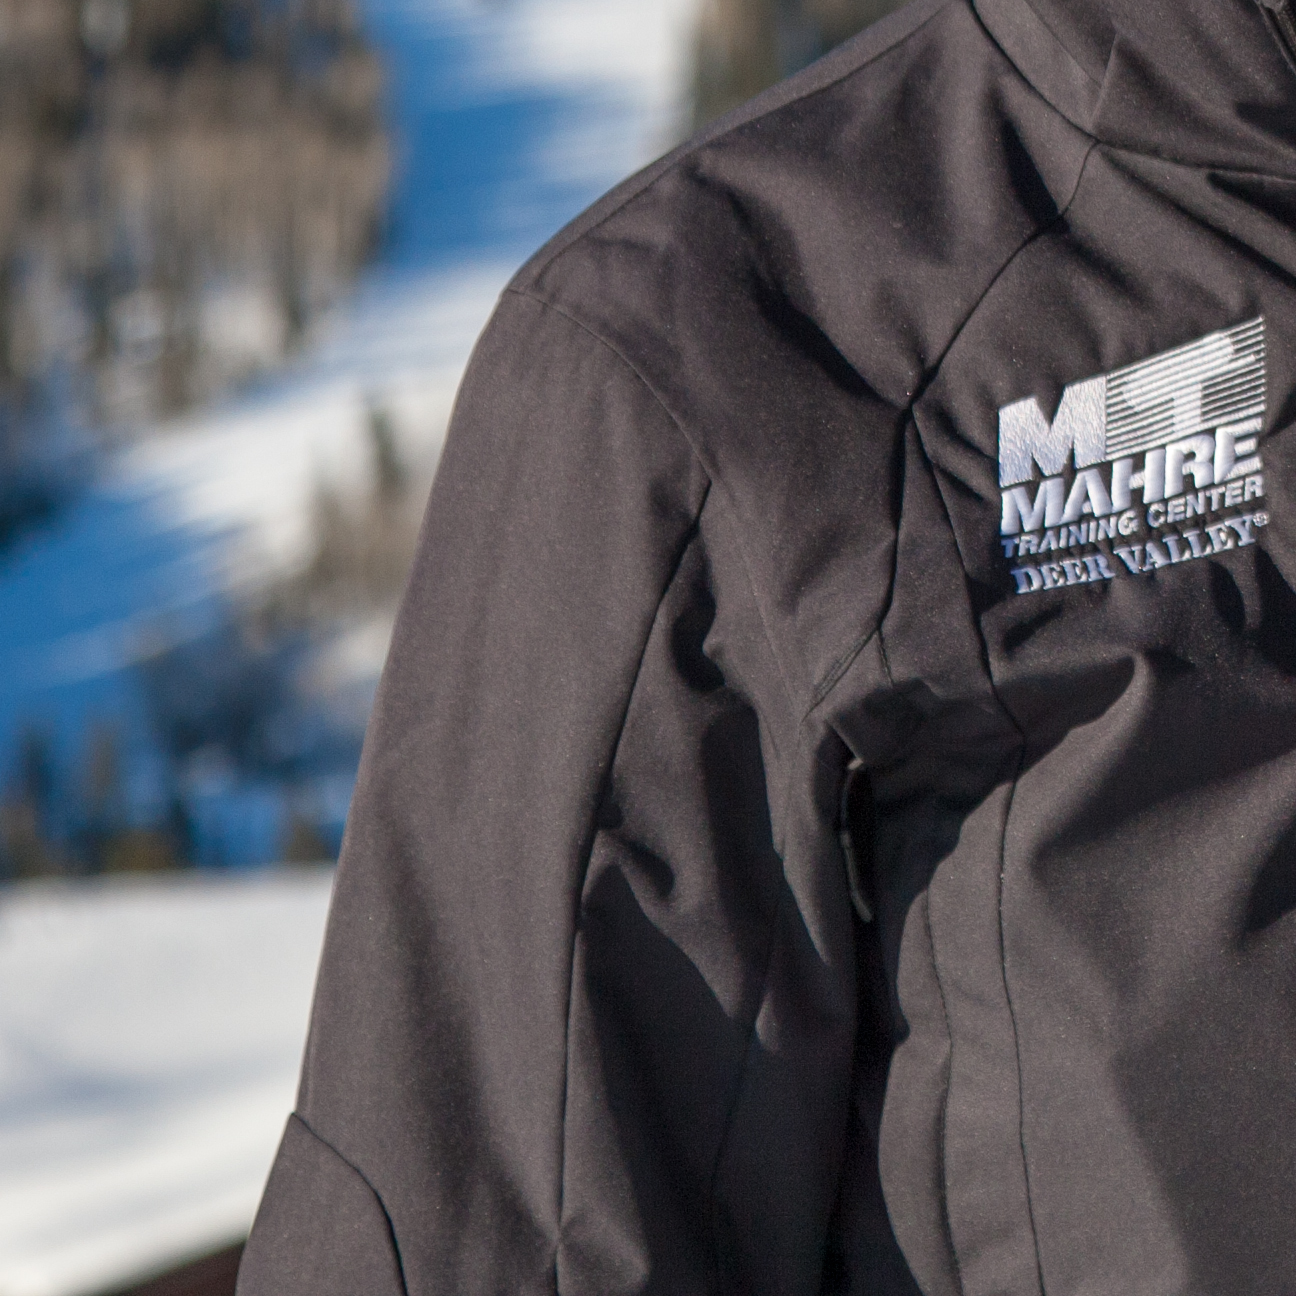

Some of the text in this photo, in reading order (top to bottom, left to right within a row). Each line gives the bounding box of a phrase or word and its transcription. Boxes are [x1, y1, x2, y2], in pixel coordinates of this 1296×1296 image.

[1000, 416, 1263, 536] MAHRE
[1000, 474, 1264, 558] TRAINING CENTER
[1011, 554, 1116, 594] DEER
